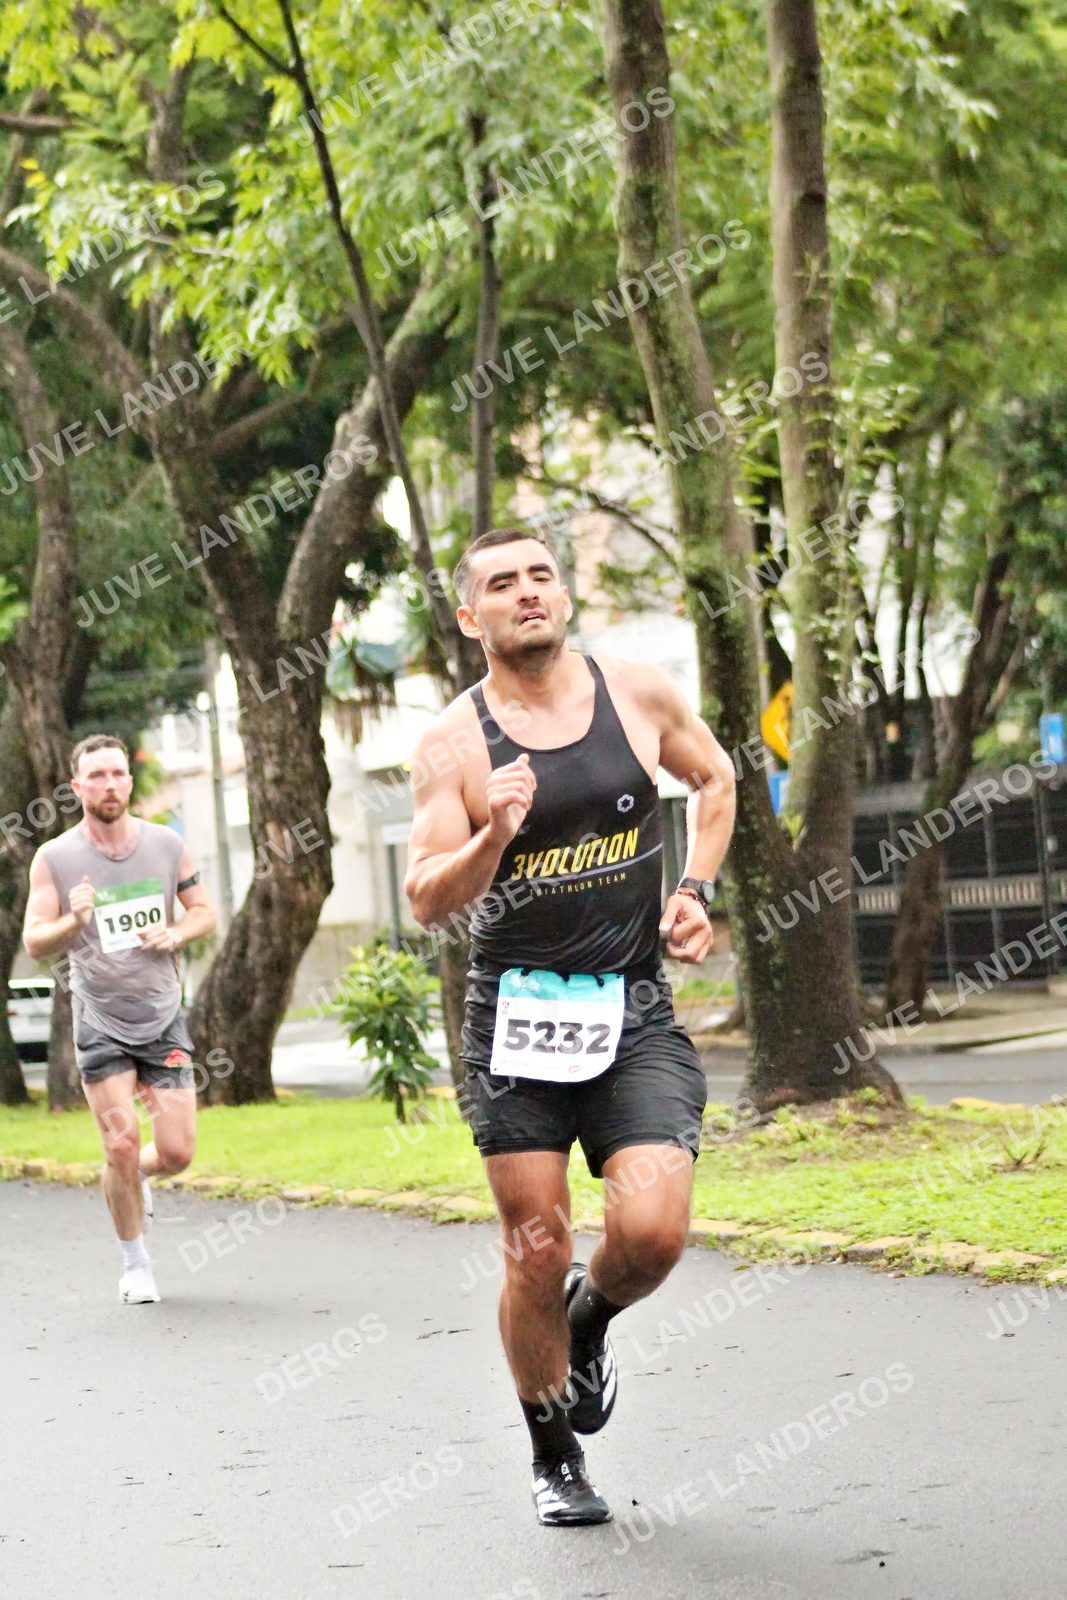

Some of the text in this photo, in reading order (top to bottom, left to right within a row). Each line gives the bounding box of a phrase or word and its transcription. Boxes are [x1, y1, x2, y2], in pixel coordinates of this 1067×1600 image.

[511, 827, 639, 881] 3VOLUTION
[530, 872, 626, 896] TRIATHLON TEAM
[104, 907, 161, 935] 1900
[502, 1018, 611, 1055] 5232
